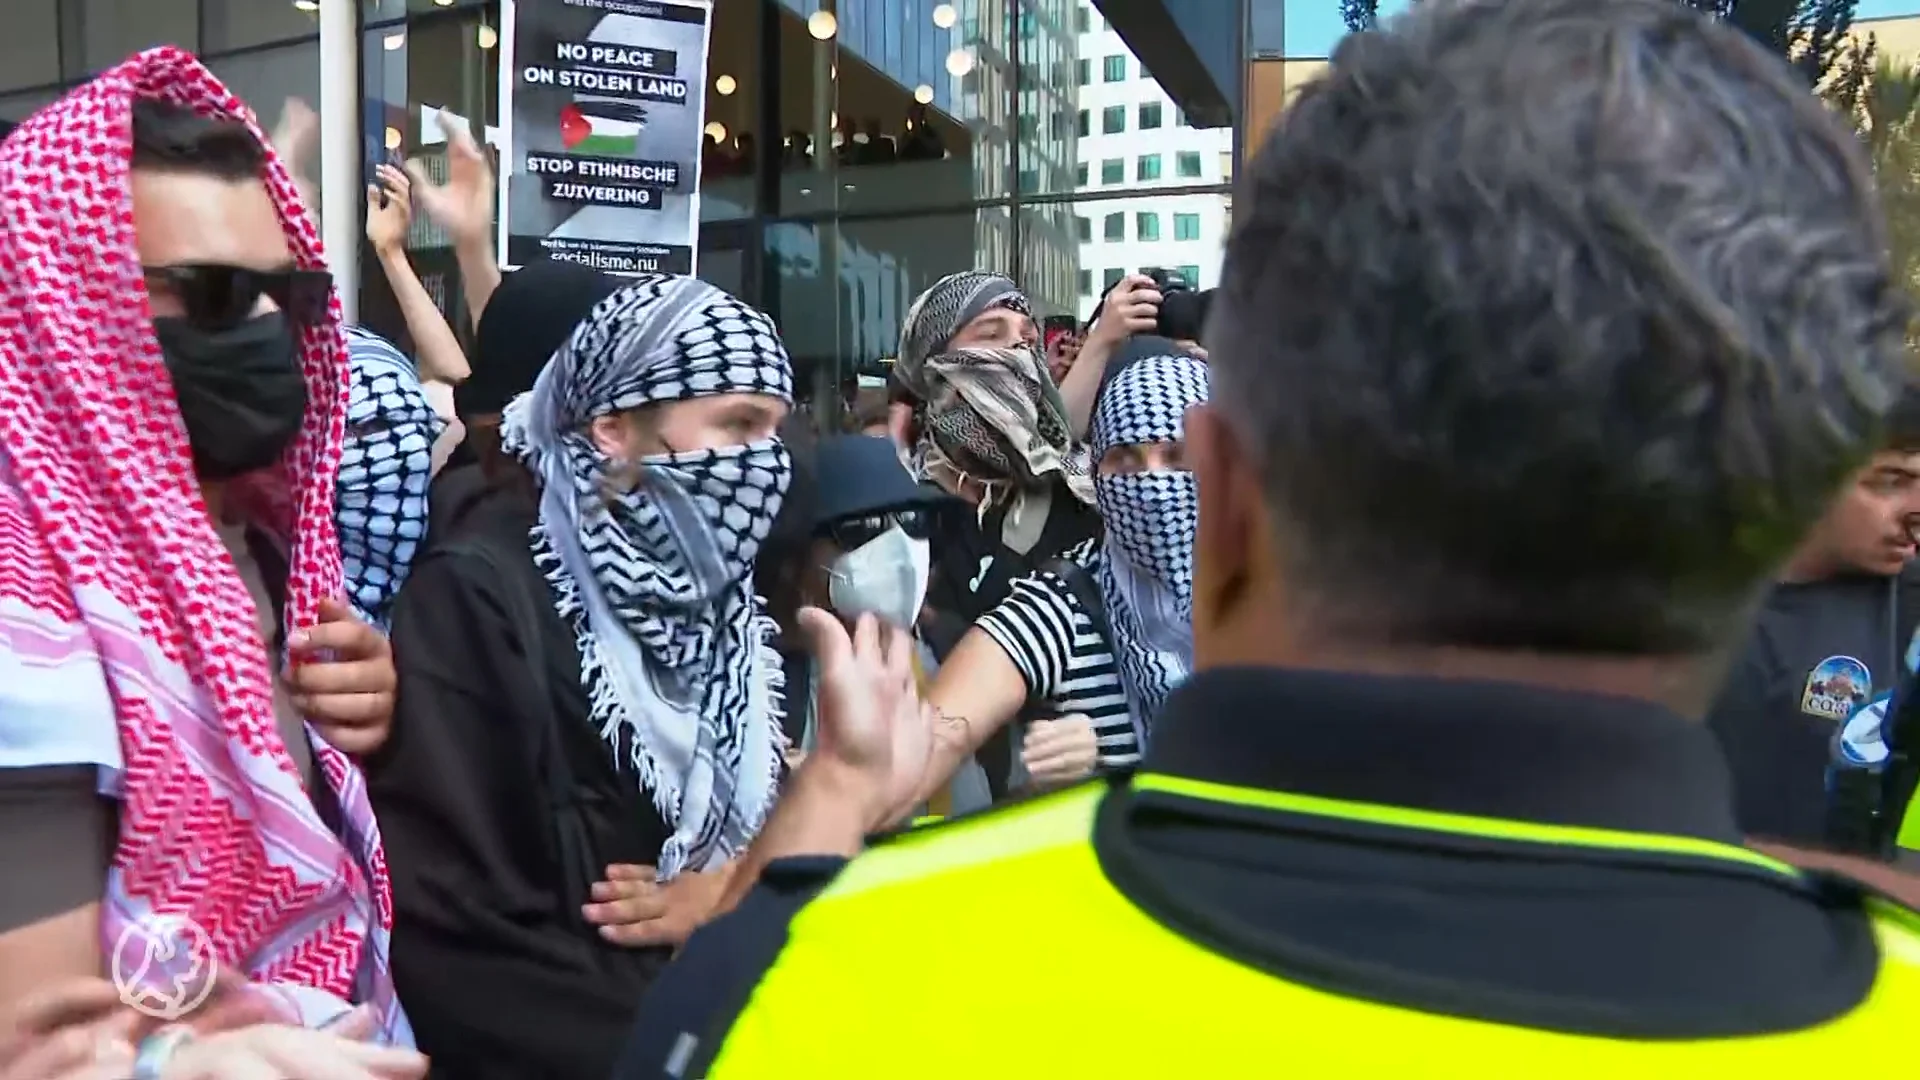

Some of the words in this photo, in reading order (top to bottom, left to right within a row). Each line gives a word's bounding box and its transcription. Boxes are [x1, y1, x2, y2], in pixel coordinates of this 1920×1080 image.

[557, 43, 587, 60] NO
[592, 47, 653, 67] PEACE
[524, 67, 554, 84] ON
[559, 70, 632, 92] STOLEN
[637, 79, 686, 97] LAND
[527, 157, 573, 174] STOP
[578, 160, 676, 182] ETHNISCHE
[552, 183, 650, 204] ZUIVERING
[551, 251, 658, 271] socialisme.nu
